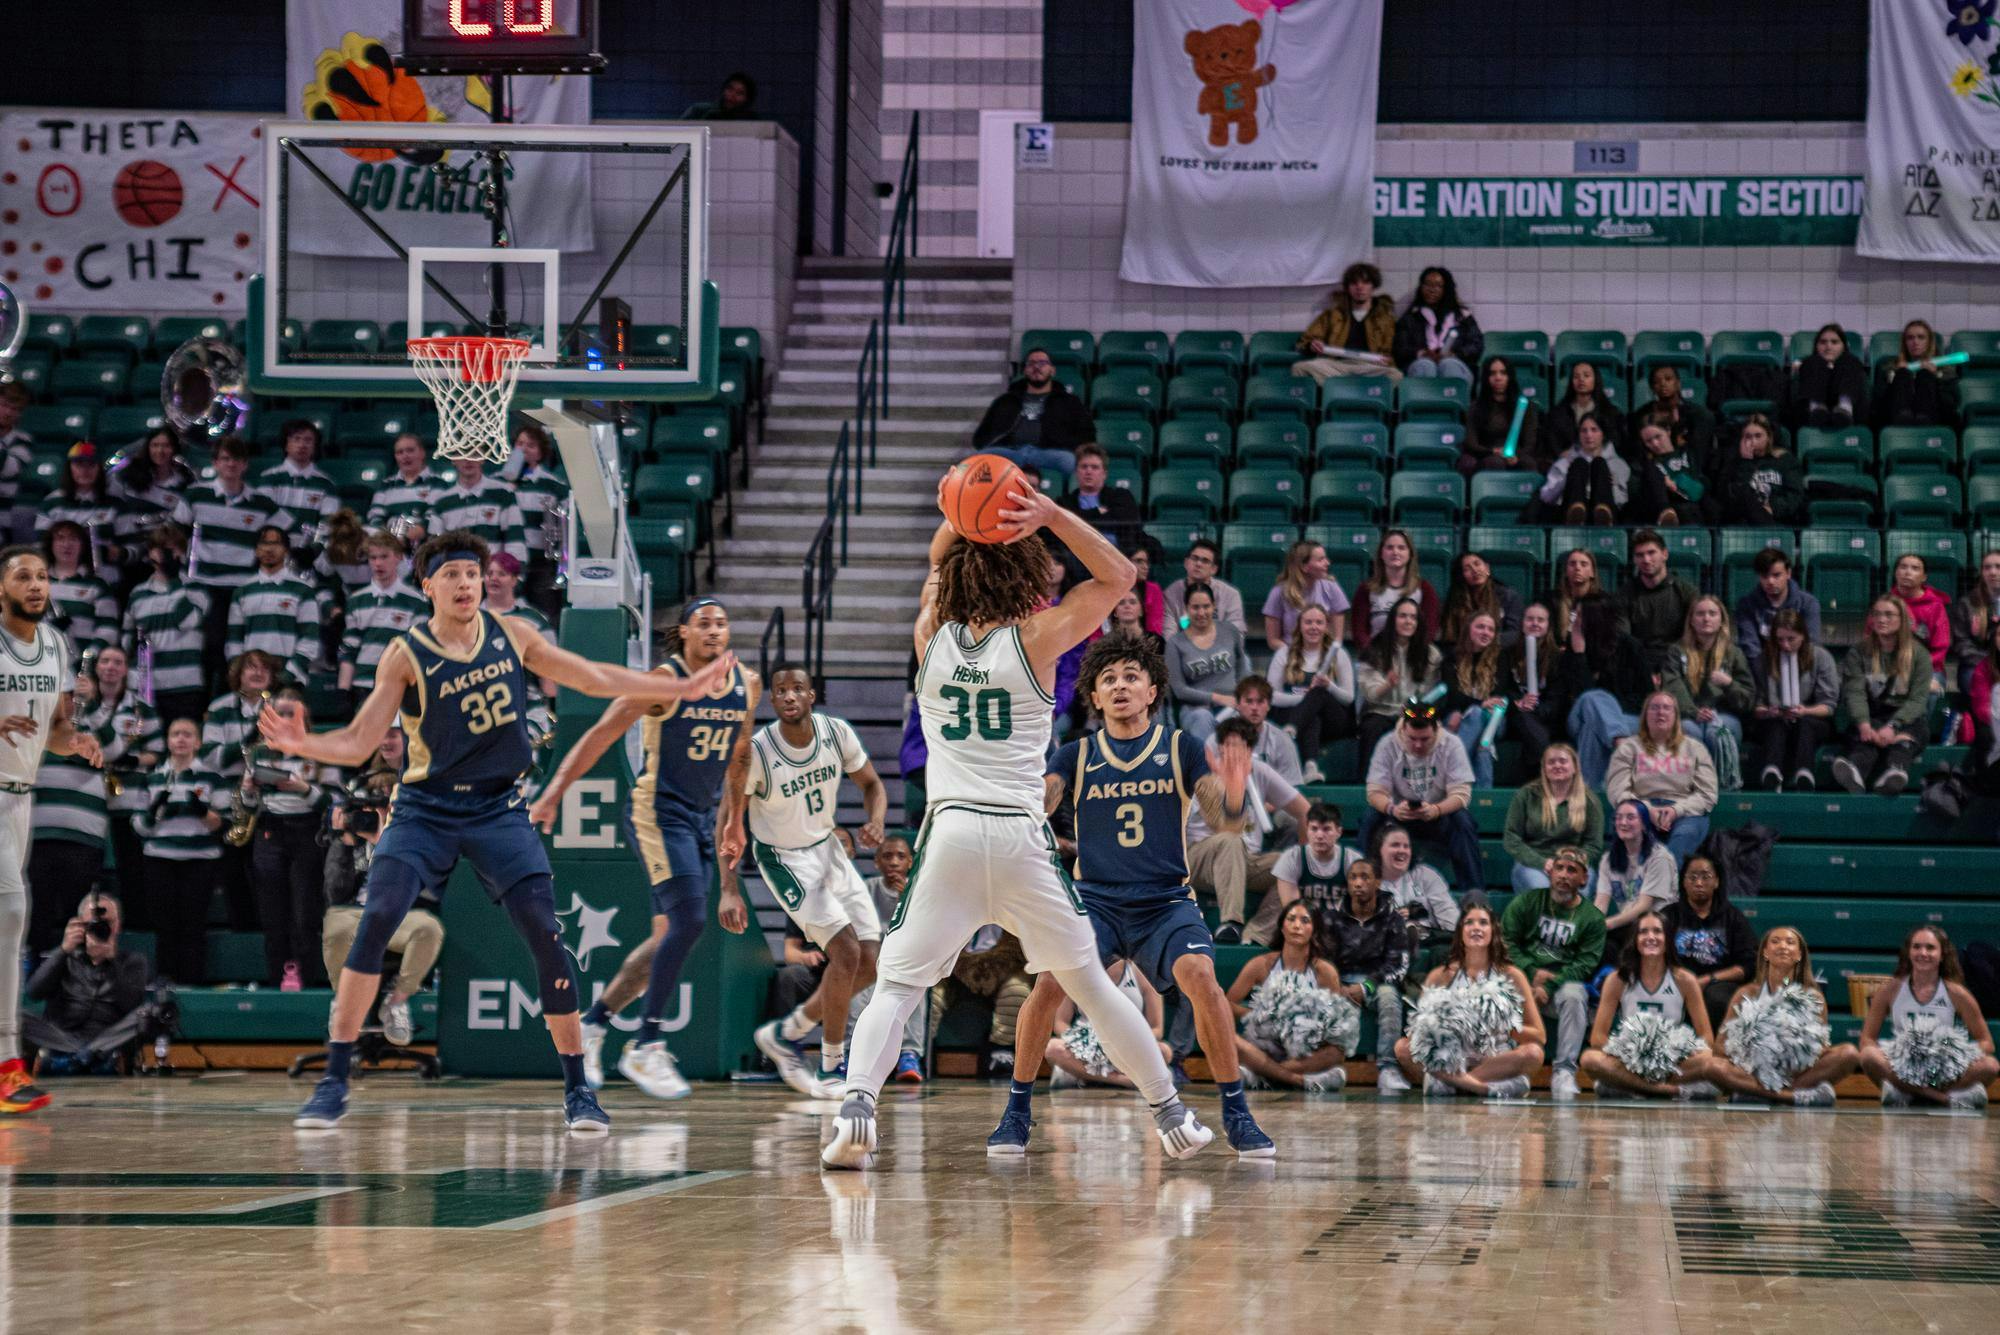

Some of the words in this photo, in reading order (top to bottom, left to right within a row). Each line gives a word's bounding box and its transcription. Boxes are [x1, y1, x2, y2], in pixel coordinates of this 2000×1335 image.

[1222, 82, 1246, 111] E
[37, 119, 200, 154] THETA
[1025, 127, 1047, 150] E
[1160, 155, 1200, 170] LOVES
[1588, 146, 1626, 165] 113
[349, 162, 396, 212] GO
[1437, 181, 1562, 218] NATION
[1574, 180, 1727, 218] STUDENT
[74, 238, 206, 290] CHI
[438, 658, 514, 699] AKRON
[951, 664, 990, 685] HENRY
[27, 699, 35, 720] 1
[460, 682, 518, 736] 32
[680, 706, 748, 723] AKRON
[939, 683, 1013, 741] 30
[686, 725, 734, 762] 34
[780, 763, 837, 799] EASTERN
[1086, 778, 1174, 801] AKRON
[553, 779, 616, 849] E
[804, 788, 825, 816] 13
[1115, 802, 1145, 848] 3
